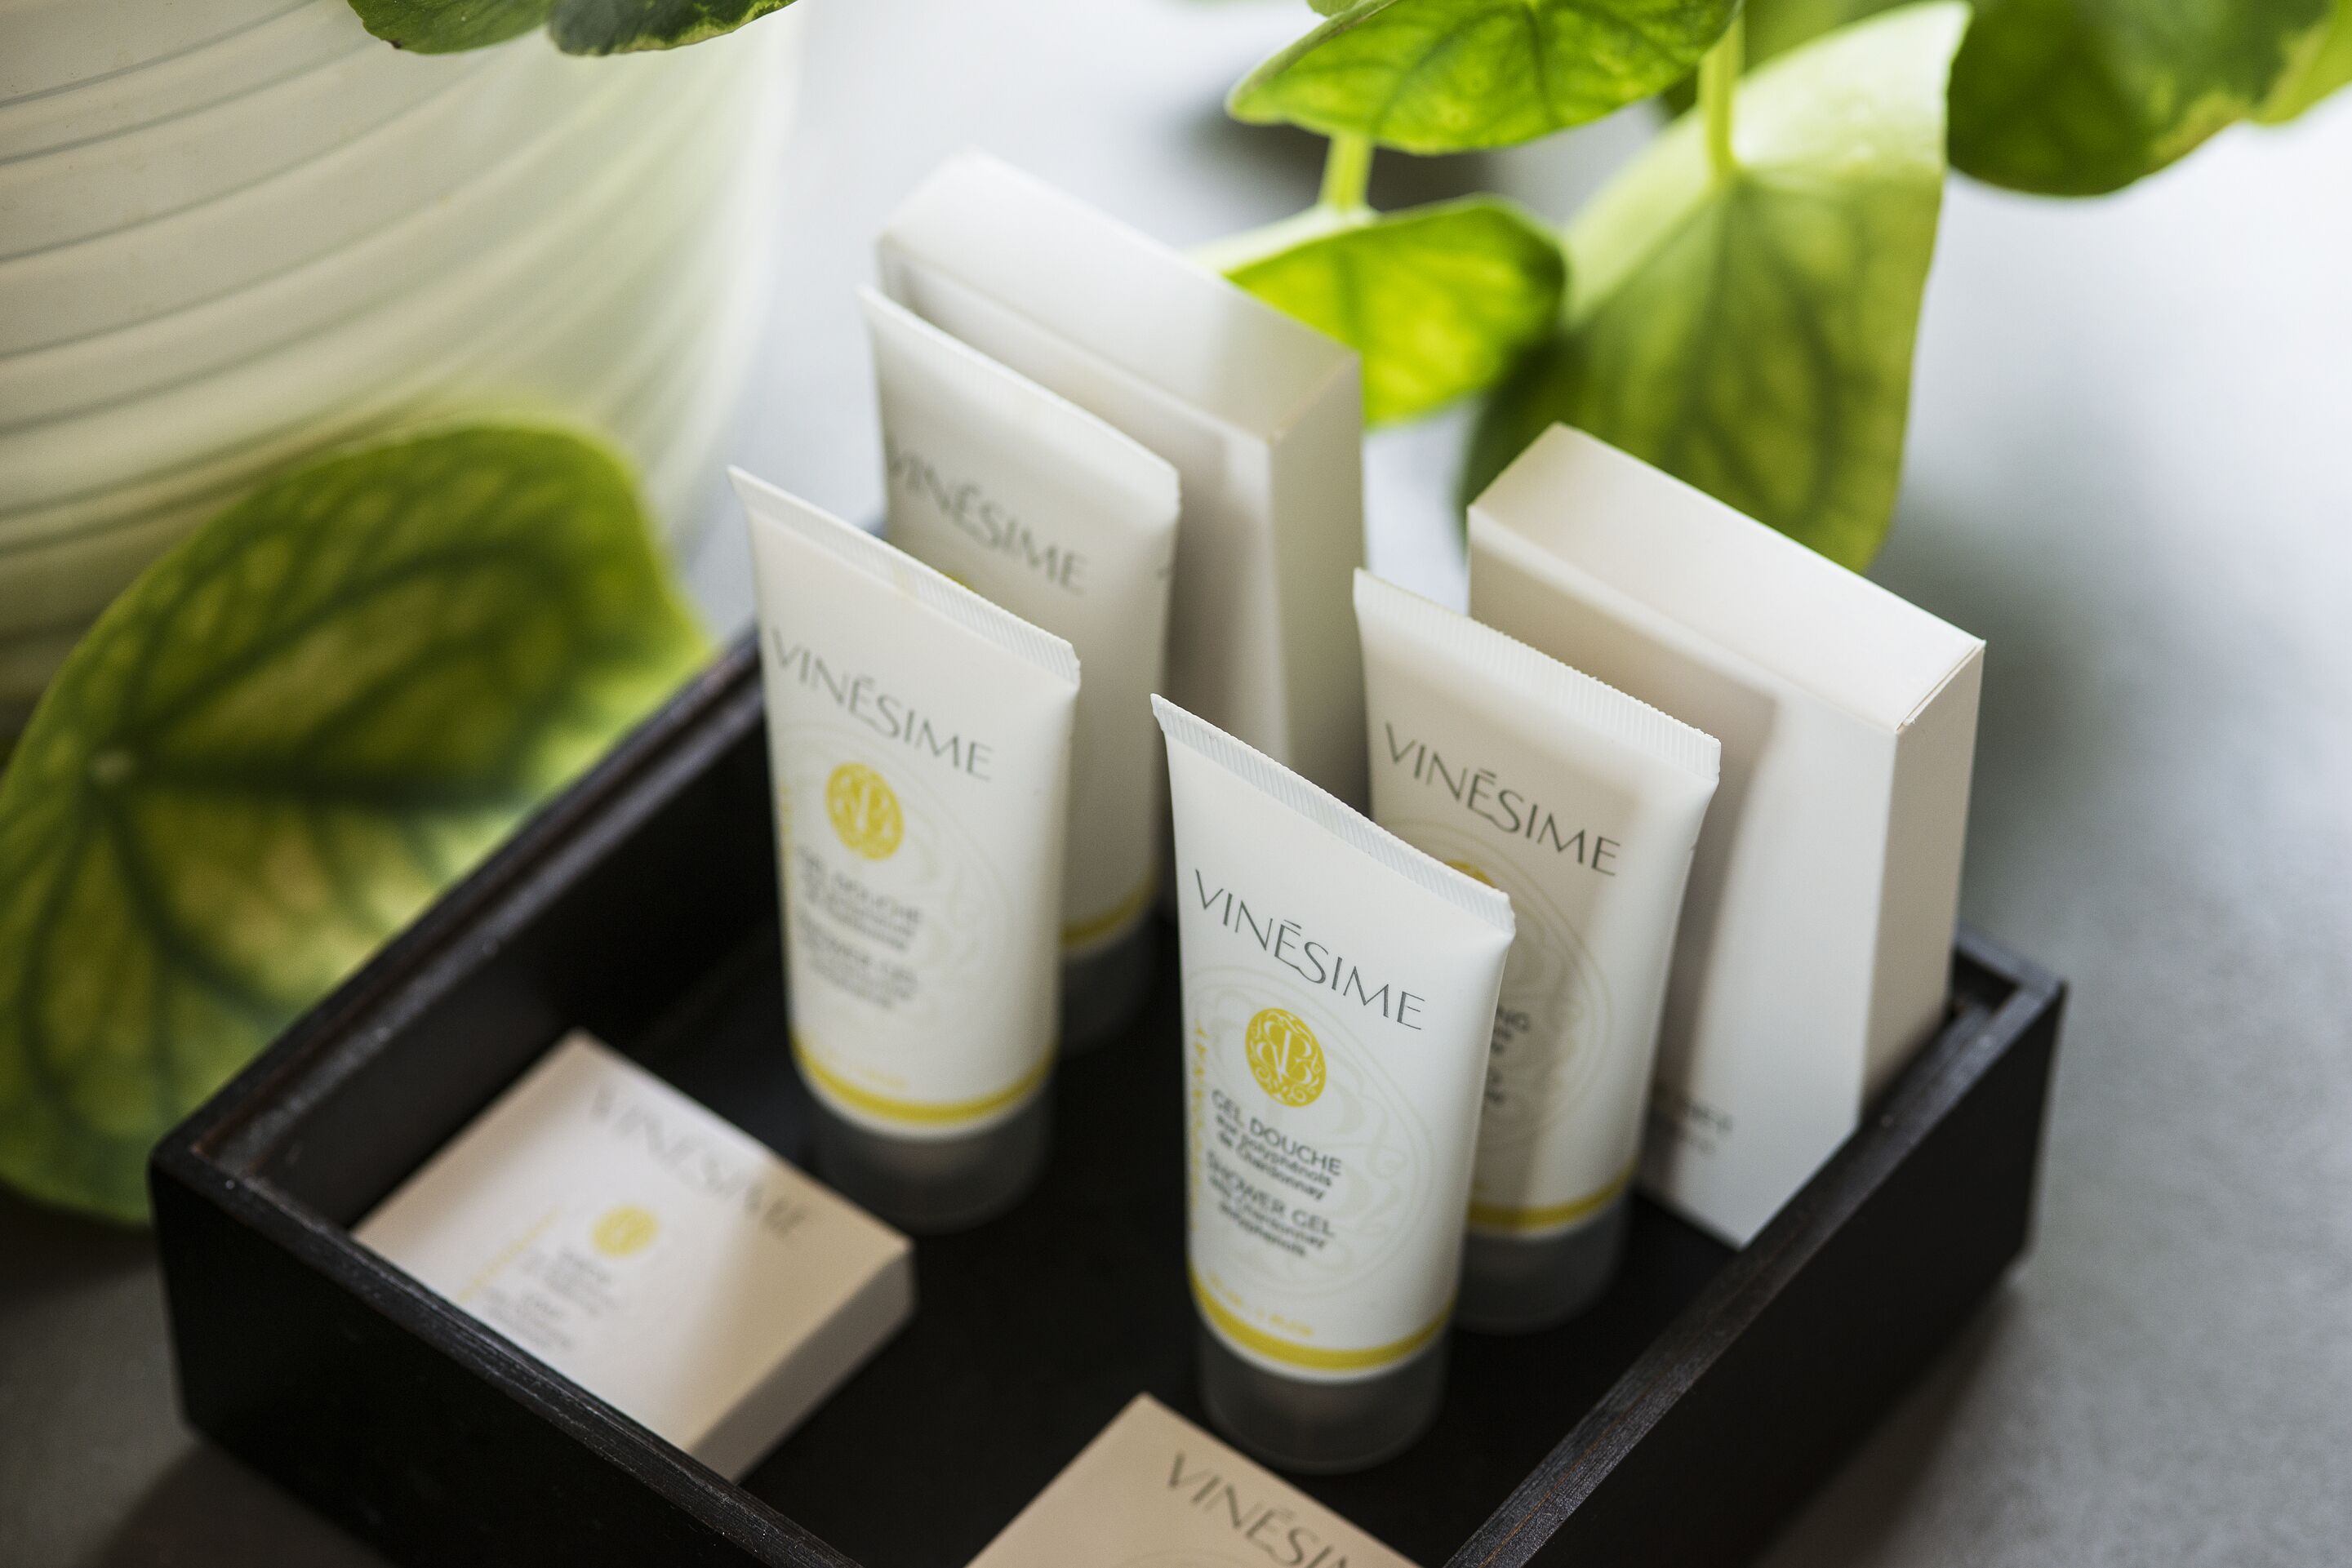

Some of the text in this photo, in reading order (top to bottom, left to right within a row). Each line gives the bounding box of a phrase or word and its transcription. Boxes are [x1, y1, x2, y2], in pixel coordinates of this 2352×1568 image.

[1385, 721, 1621, 877] VINÉSIME
[1194, 868, 1426, 1030] VINÉSIME
[1212, 1089, 1342, 1176] GEL DOUCHE
